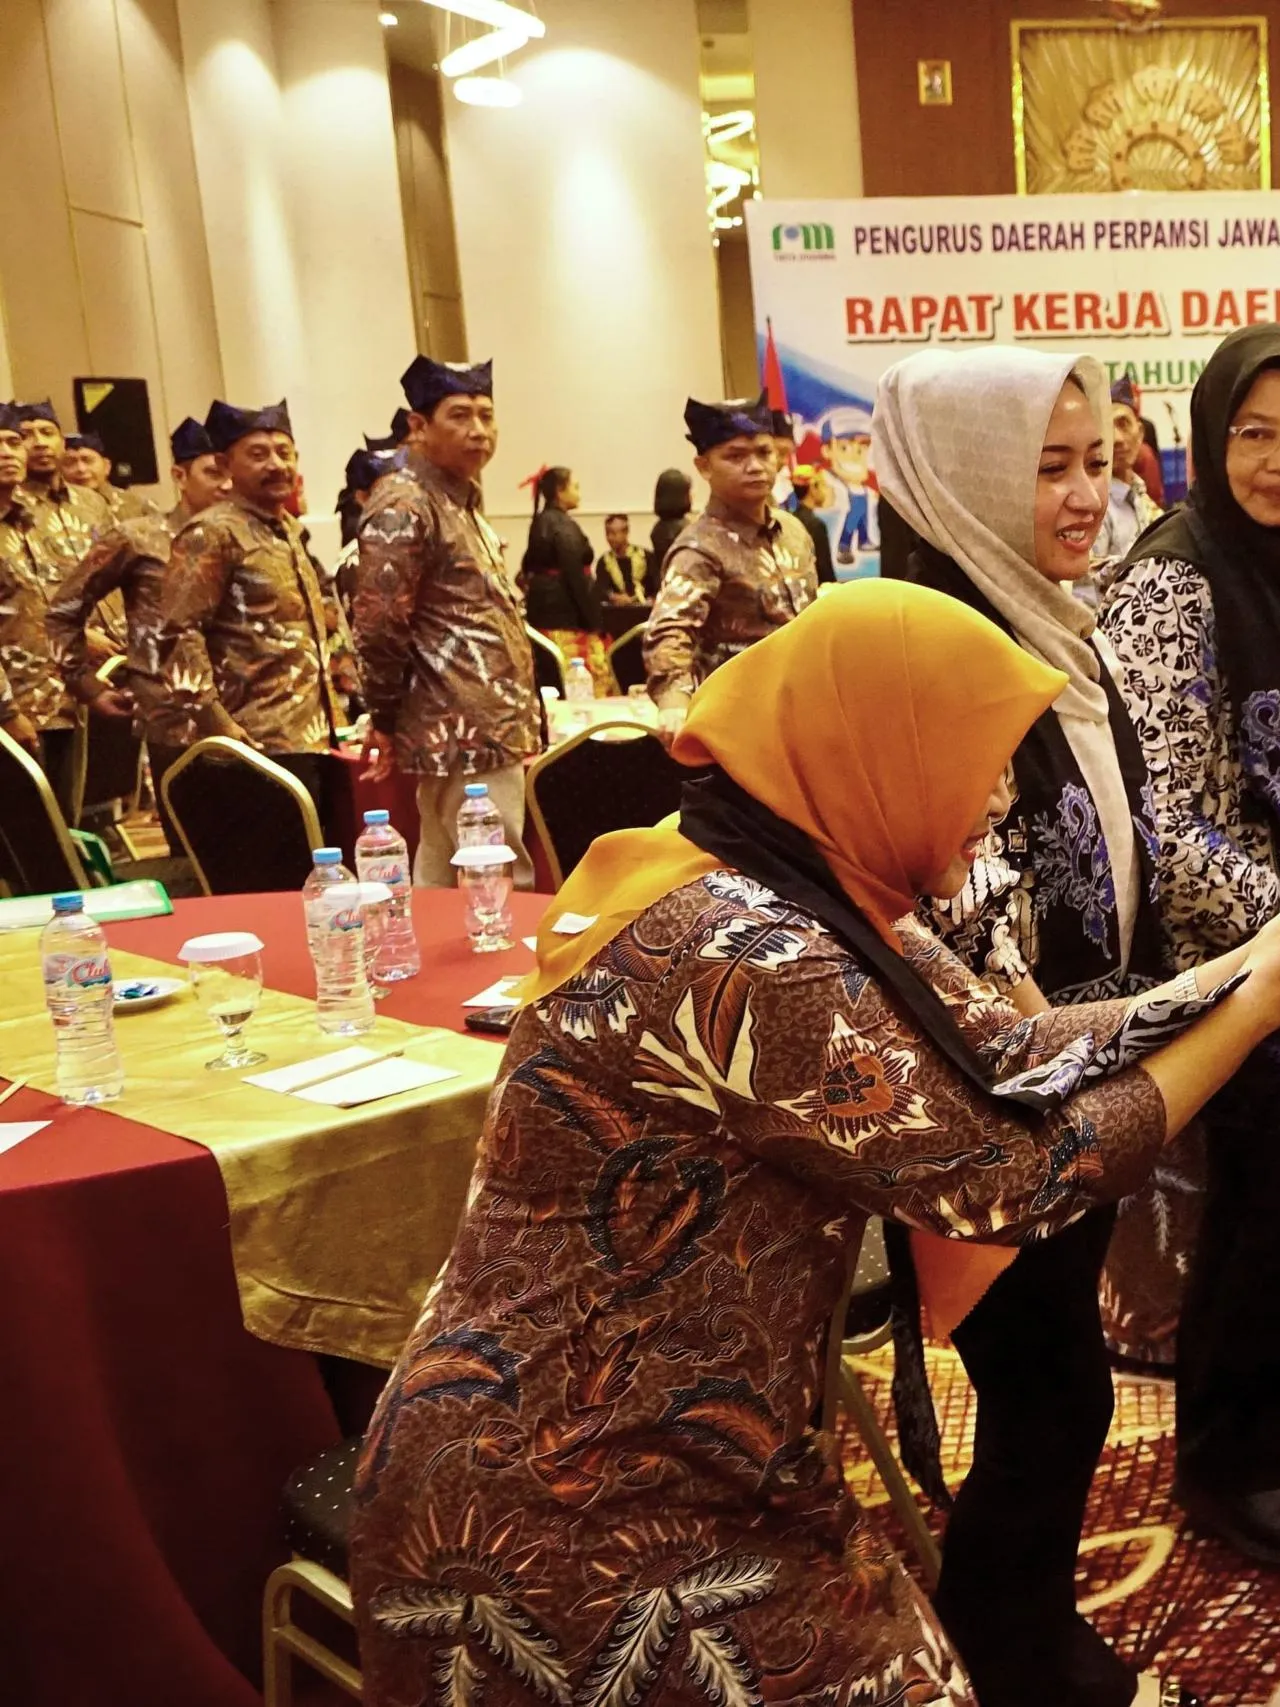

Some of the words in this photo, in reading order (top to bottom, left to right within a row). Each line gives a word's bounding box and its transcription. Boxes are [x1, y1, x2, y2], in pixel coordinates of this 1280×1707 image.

[854, 223, 983, 255] PENGURUS
[992, 220, 1085, 252] DAERAH
[1094, 219, 1209, 250] PERPAMSI
[1218, 218, 1280, 248] JAWA
[845, 294, 995, 337] RAPAT
[1012, 290, 1165, 333] KERJA
[1103, 359, 1206, 386] TAHUN
